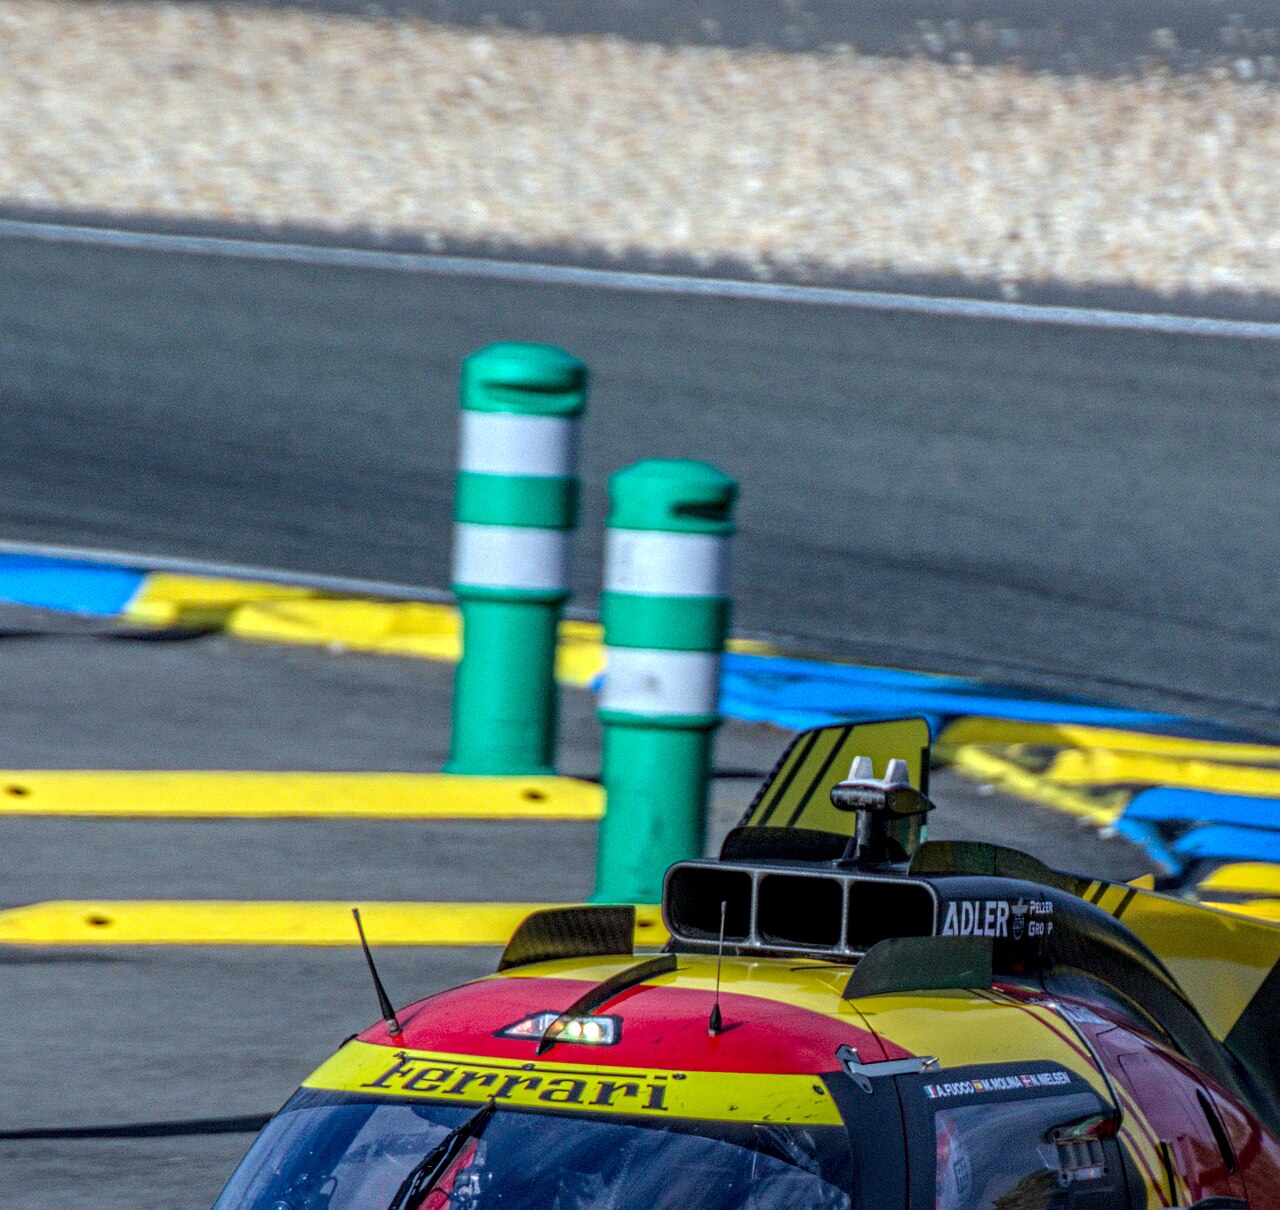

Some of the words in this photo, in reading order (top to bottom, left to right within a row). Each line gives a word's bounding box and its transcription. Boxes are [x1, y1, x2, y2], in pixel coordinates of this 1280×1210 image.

[942, 901, 1010, 937] ADLER
[1029, 900, 1053, 915] PELZER
[1028, 921, 1053, 937] GROP
[360, 1056, 669, 1111] Ferrari
